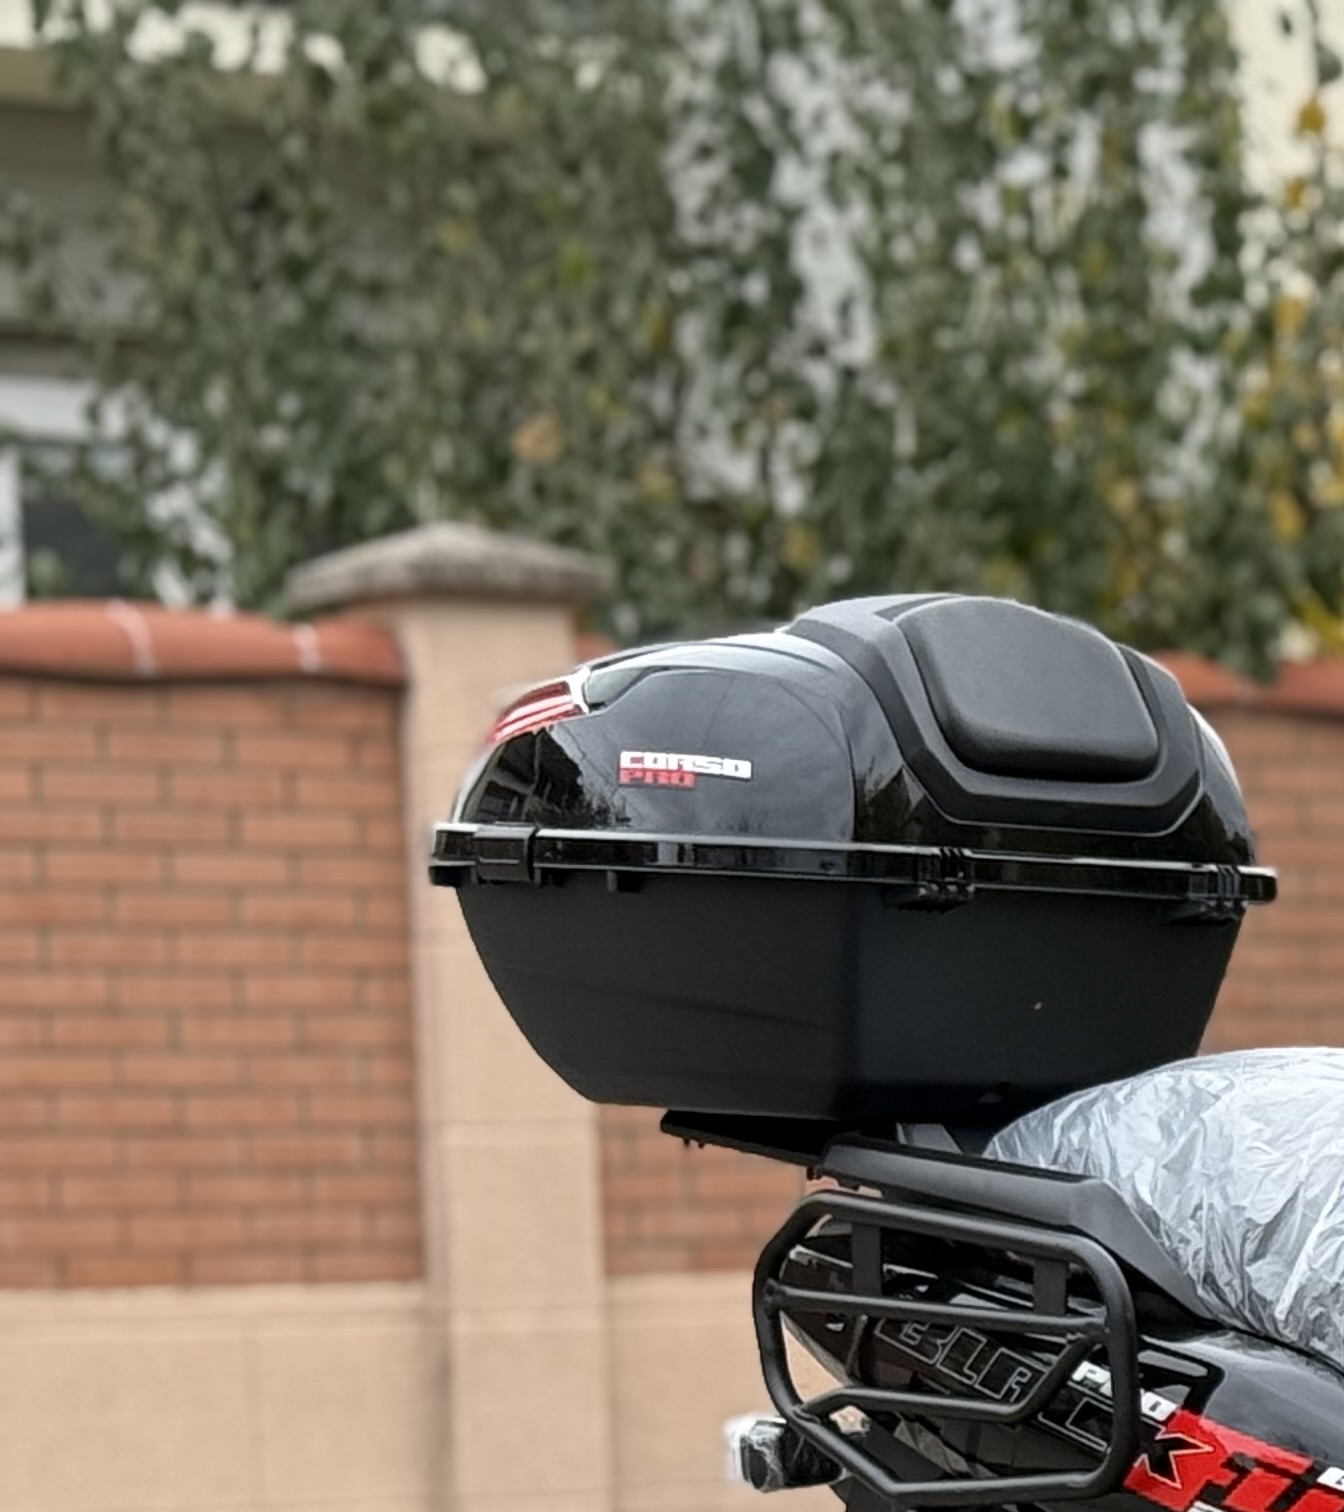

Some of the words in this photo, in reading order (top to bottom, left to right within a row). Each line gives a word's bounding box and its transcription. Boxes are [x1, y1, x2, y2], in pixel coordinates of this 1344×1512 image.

[618, 768, 696, 785] PRO
[620, 751, 752, 779] CORSO
[1071, 1360, 1178, 1423] PO
